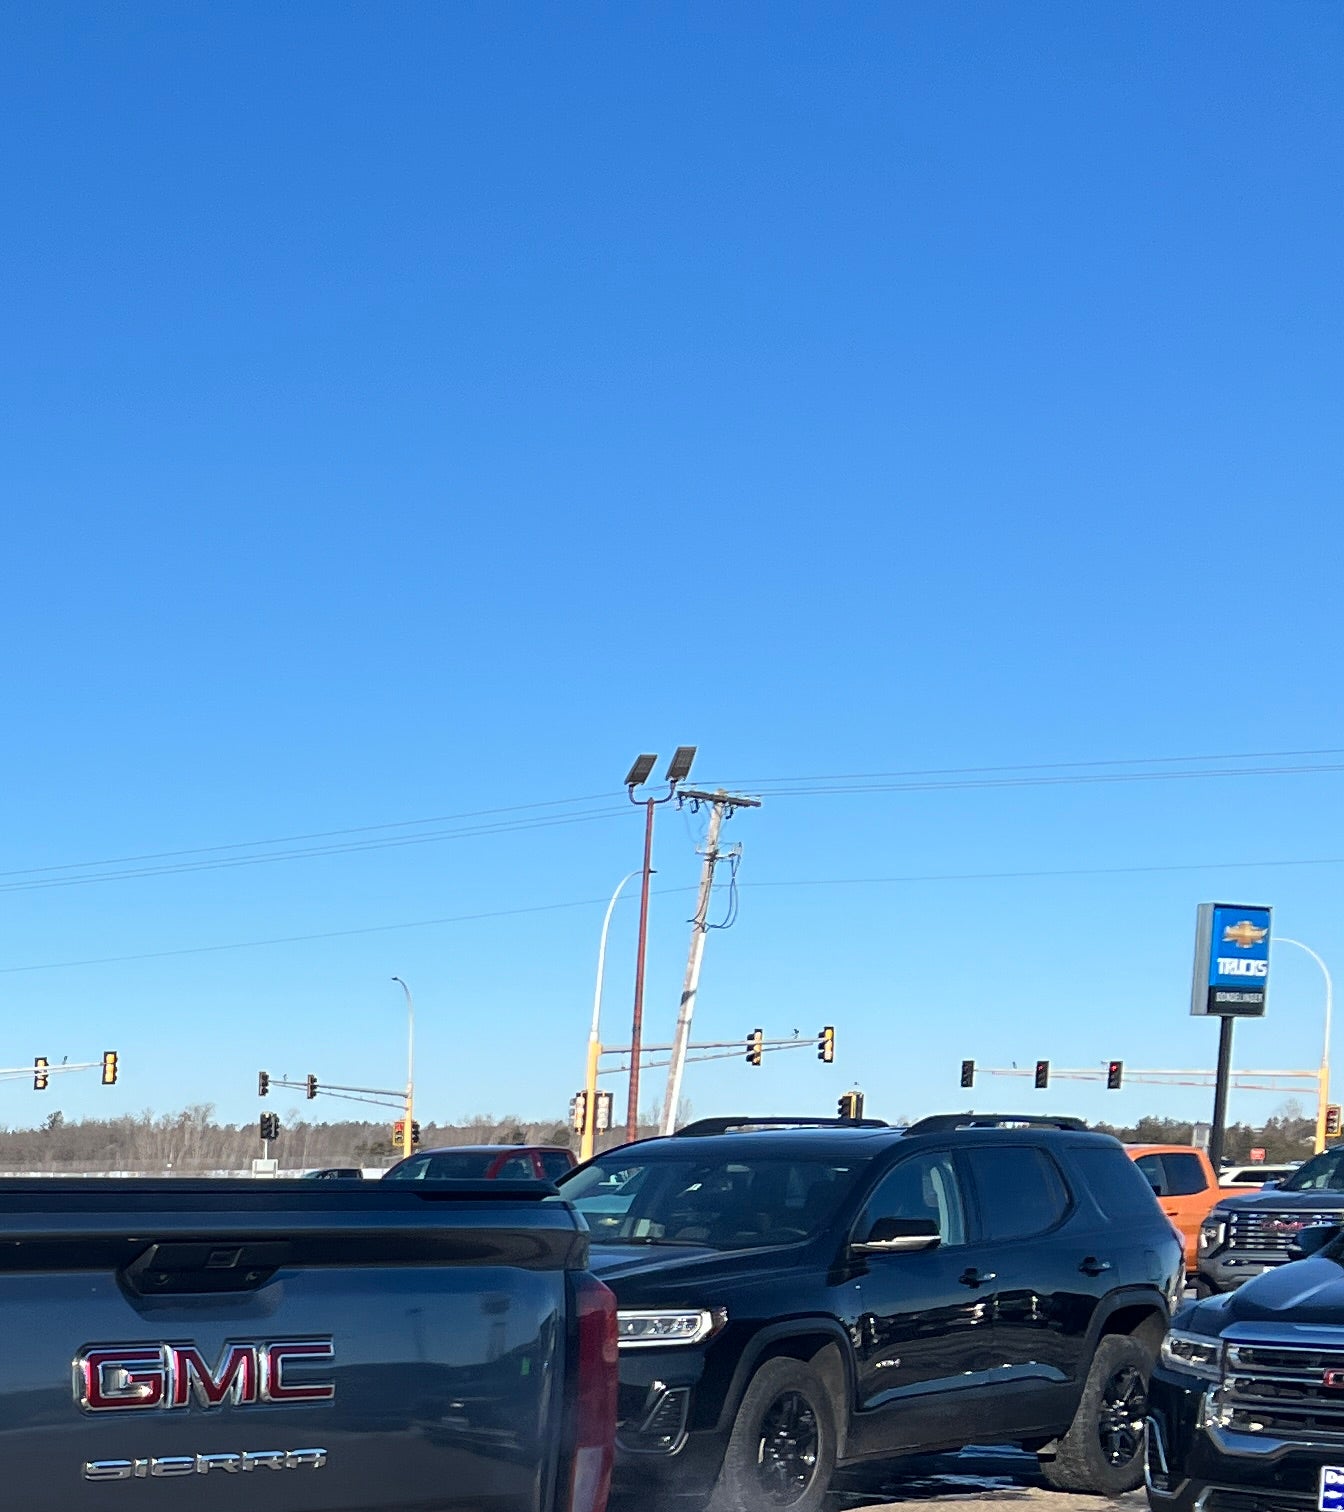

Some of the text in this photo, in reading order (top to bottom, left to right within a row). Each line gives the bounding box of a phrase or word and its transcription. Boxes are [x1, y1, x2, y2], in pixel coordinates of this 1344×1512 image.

[1217, 958, 1268, 977] TRUCKS
[72, 1335, 336, 1416] GMC
[83, 1448, 328, 1481] SIERRA
